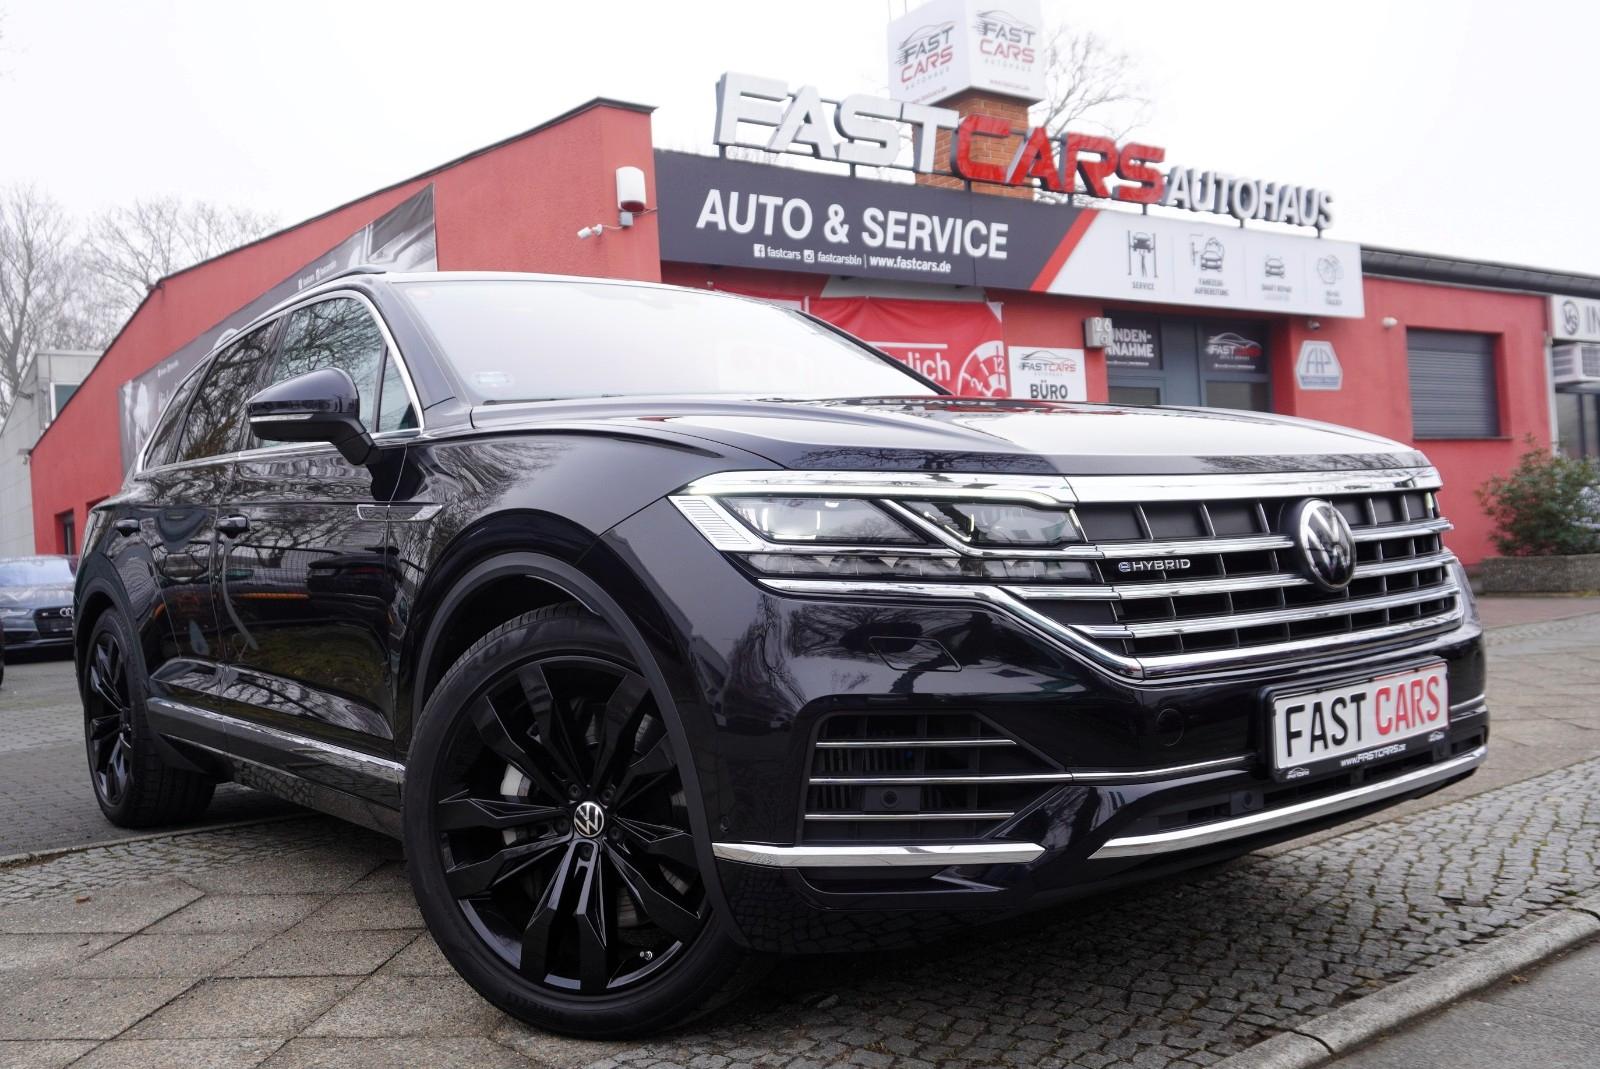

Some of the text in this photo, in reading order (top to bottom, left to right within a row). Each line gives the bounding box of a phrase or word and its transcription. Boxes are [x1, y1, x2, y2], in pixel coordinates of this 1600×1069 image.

[900, 26, 954, 64] FAST
[983, 21, 1036, 45] FAST
[901, 45, 953, 83] CARS
[980, 38, 1035, 63] CARS
[1160, 165, 1334, 229] AUTOHAUS
[695, 188, 1010, 260] AUTO & SERVICE
[767, 246, 801, 260] fastcars
[869, 255, 952, 273] www.fastcars.de
[1132, 281, 1155, 290] SERVICE
[902, 351, 951, 381] lich
[1030, 380, 1068, 399] BÜRO
[1285, 675, 1441, 758] FAST CARS
